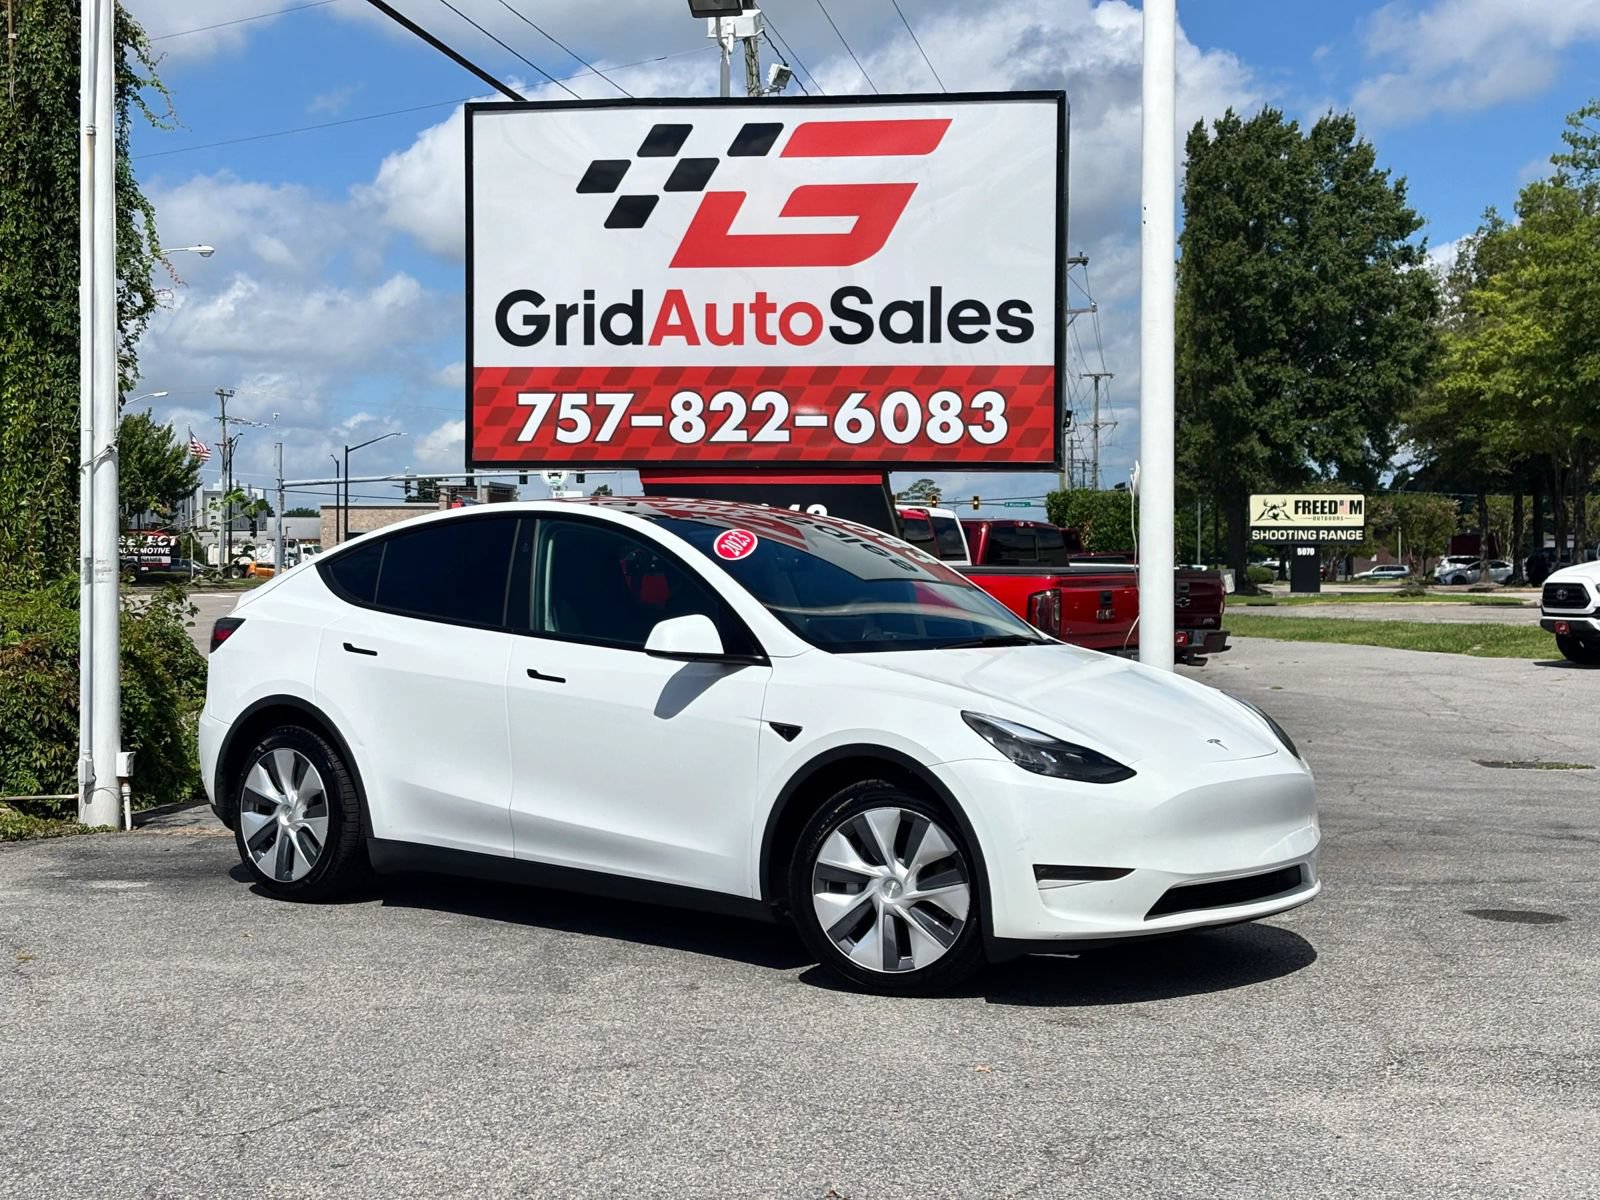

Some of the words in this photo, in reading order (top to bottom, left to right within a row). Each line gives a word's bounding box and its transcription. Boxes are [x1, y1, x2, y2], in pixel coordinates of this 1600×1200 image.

[494, 285, 1035, 347] GridAutoSales
[516, 390, 1009, 446] 757-822-6083
[1294, 500, 1362, 515] FREEDM
[720, 531, 751, 557] 2023
[1252, 530, 1317, 540] SHOOTING
[1319, 530, 1363, 540] RANGE
